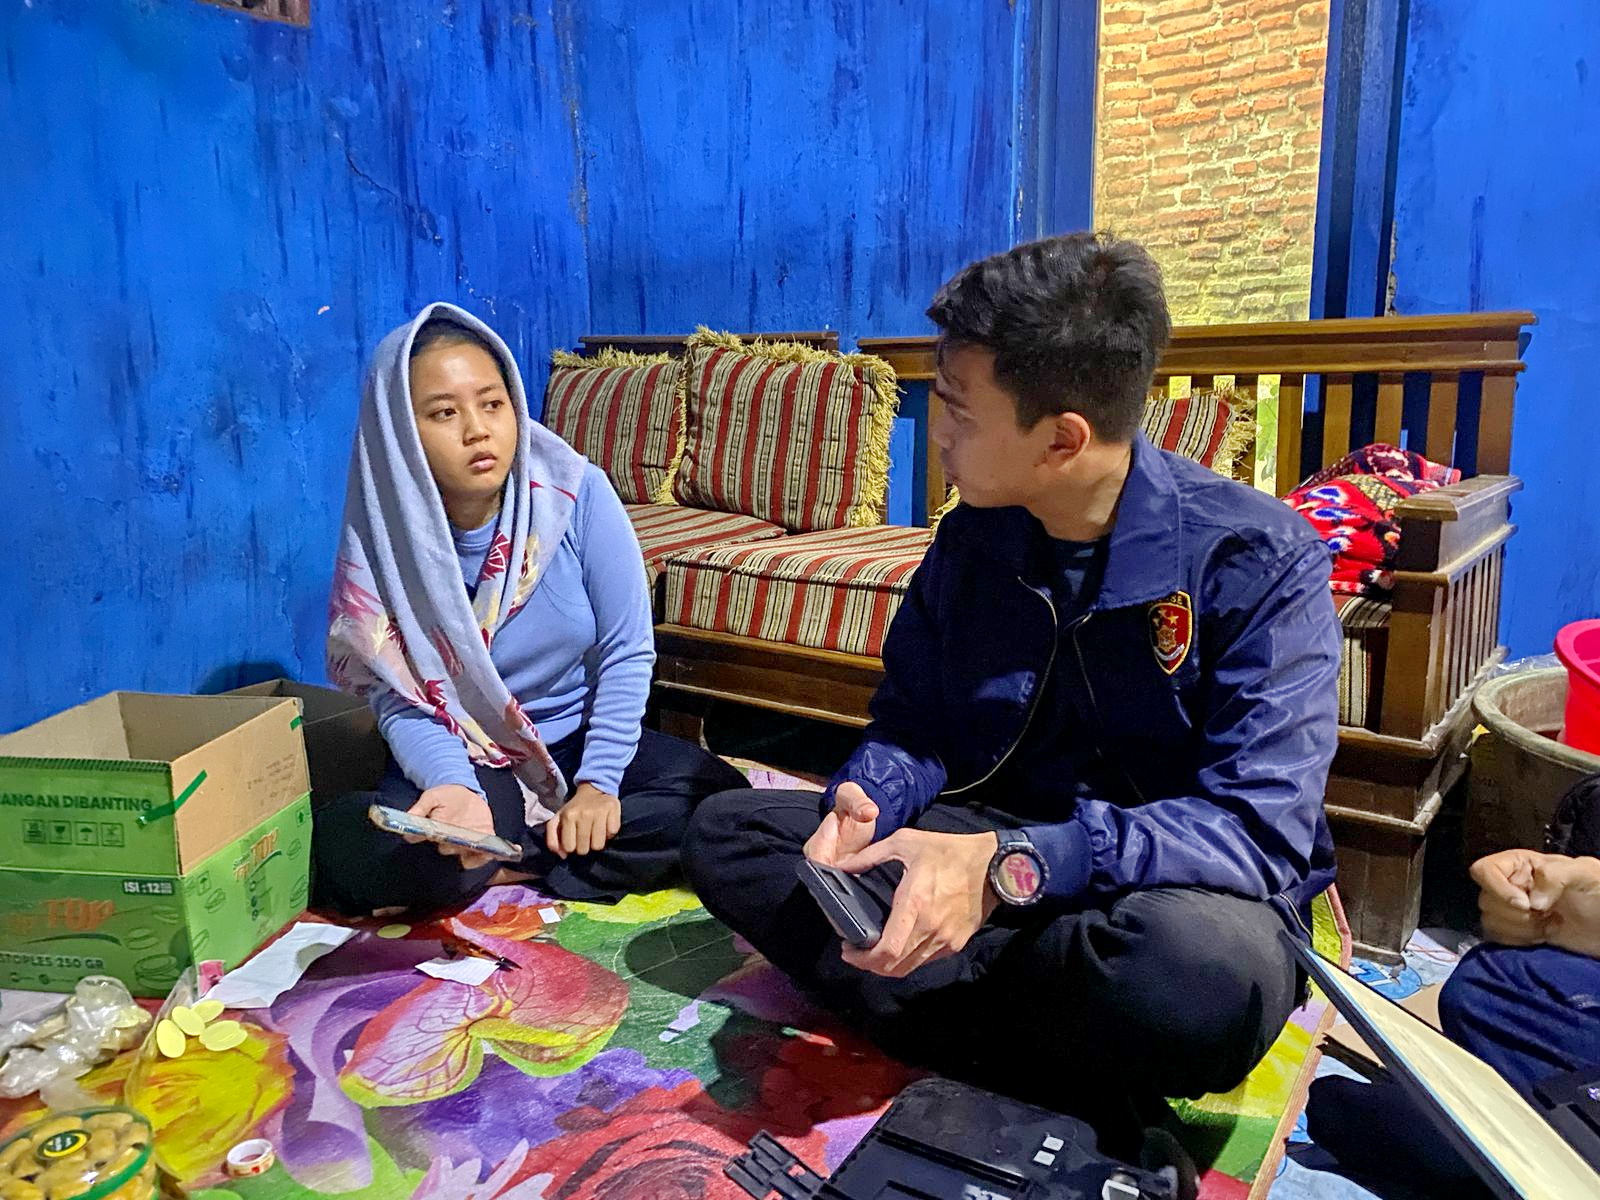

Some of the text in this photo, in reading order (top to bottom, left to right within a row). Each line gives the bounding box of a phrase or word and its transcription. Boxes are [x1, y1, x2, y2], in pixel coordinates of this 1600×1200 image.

[62, 795, 153, 811] DIBANTING
[124, 881, 140, 893] ISI
[84, 957, 104, 970] GR
